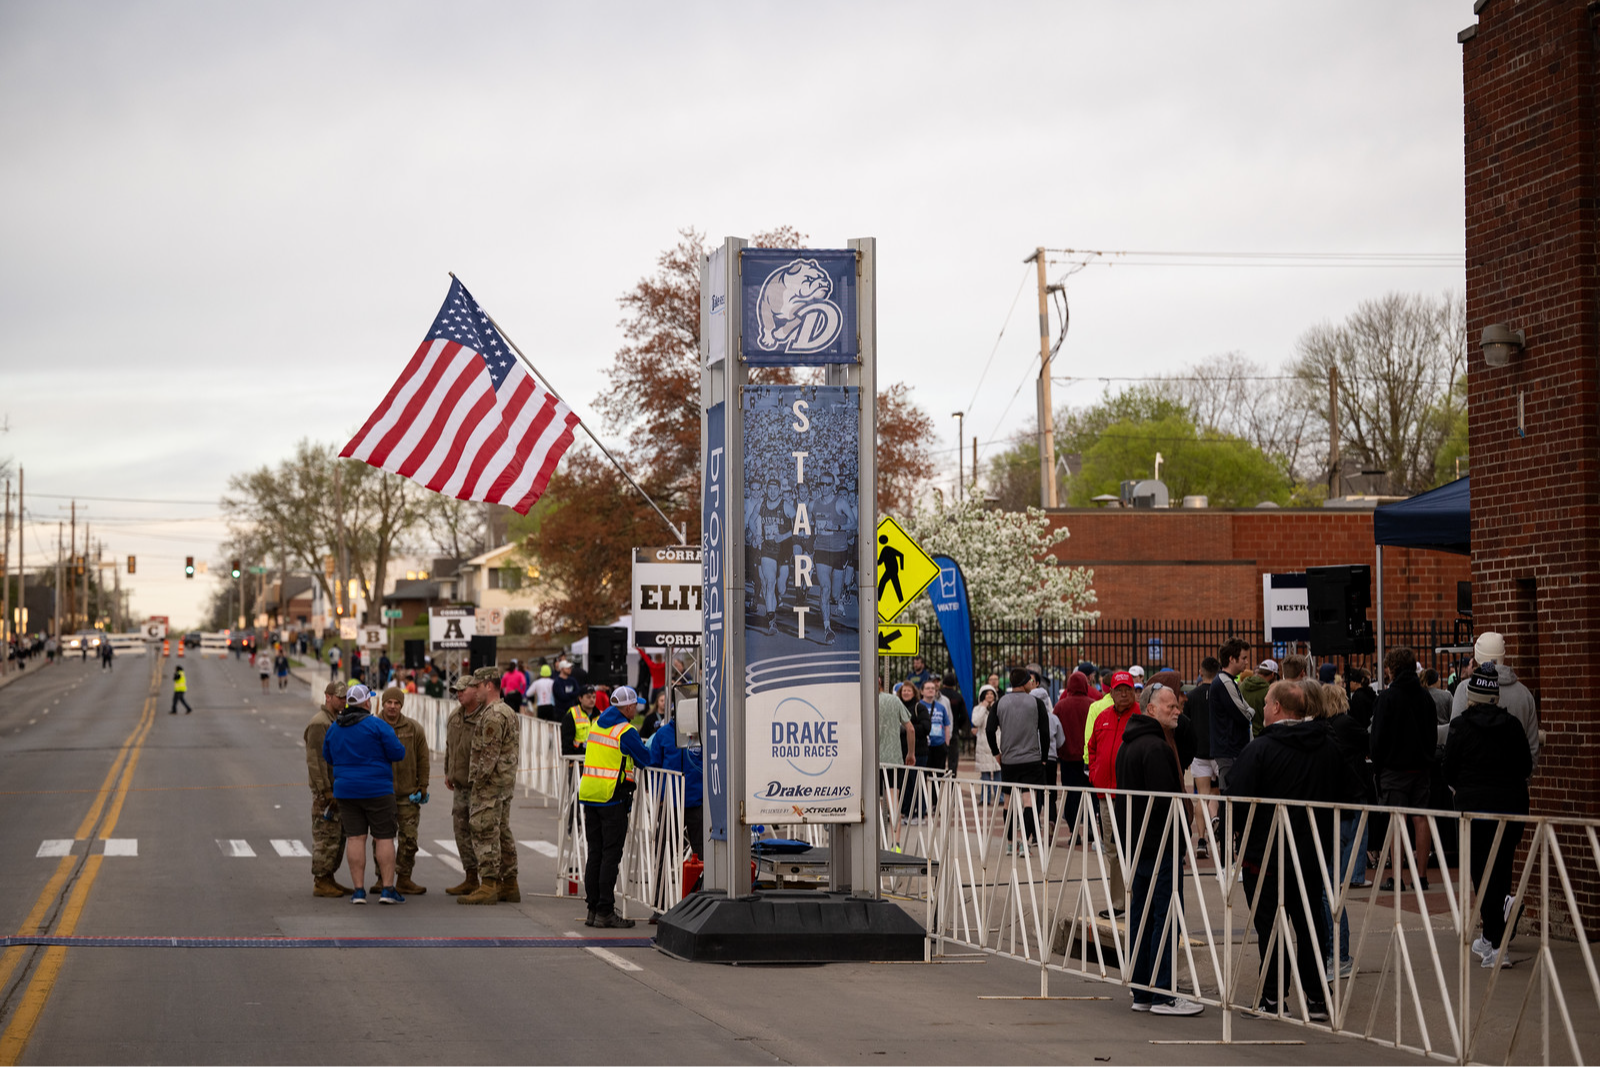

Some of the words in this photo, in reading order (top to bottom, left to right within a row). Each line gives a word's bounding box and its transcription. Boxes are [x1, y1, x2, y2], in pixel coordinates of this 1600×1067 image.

[792, 400, 813, 639] START
[656, 550, 703, 561] CORRA
[640, 584, 703, 611] ELIT
[1276, 604, 1309, 612] RESTR
[709, 446, 724, 796] broadlawns
[148, 625, 159, 638] C
[443, 618, 465, 639] A
[366, 631, 380, 643] B
[655, 634, 703, 645] CORRA
[771, 721, 839, 744] DRAKE
[771, 745, 800, 758] ROAD
[804, 745, 838, 757] RACES
[765, 781, 813, 797] Drake
[804, 806, 847, 814] XTREAM
